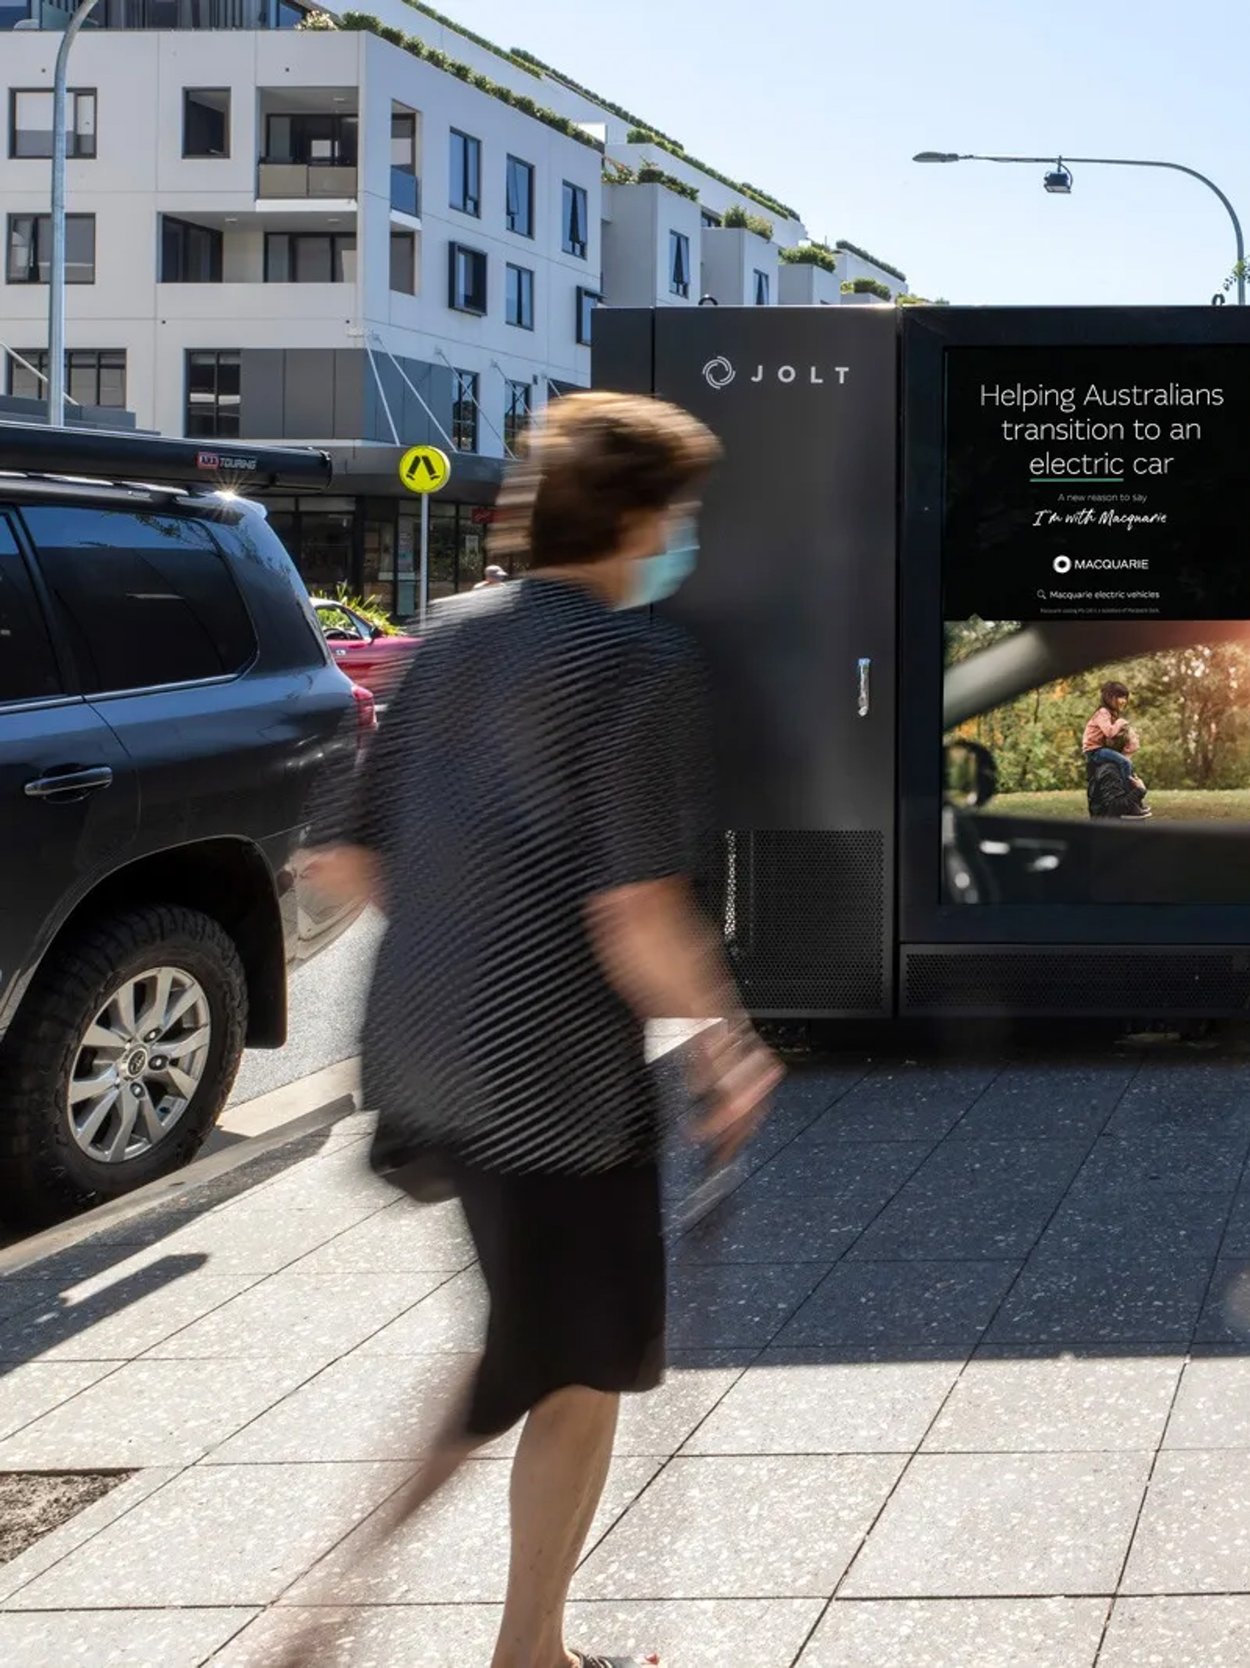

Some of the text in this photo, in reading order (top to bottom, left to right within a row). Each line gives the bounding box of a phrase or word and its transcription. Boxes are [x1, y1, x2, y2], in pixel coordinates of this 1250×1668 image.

[751, 364, 849, 384] JOLT
[980, 382, 1225, 413] Helping Australians
[1001, 418, 1202, 441] transition to an
[220, 457, 257, 470] TOURING
[1029, 451, 1175, 475] electric car
[1057, 493, 1065, 501] A
[1132, 495, 1148, 504] say
[1065, 507, 1097, 525] with
[1098, 508, 1168, 531] Macquarie
[1073, 558, 1150, 570] MACQUARIE
[1049, 590, 1160, 601] Macquarie electric vehicles
